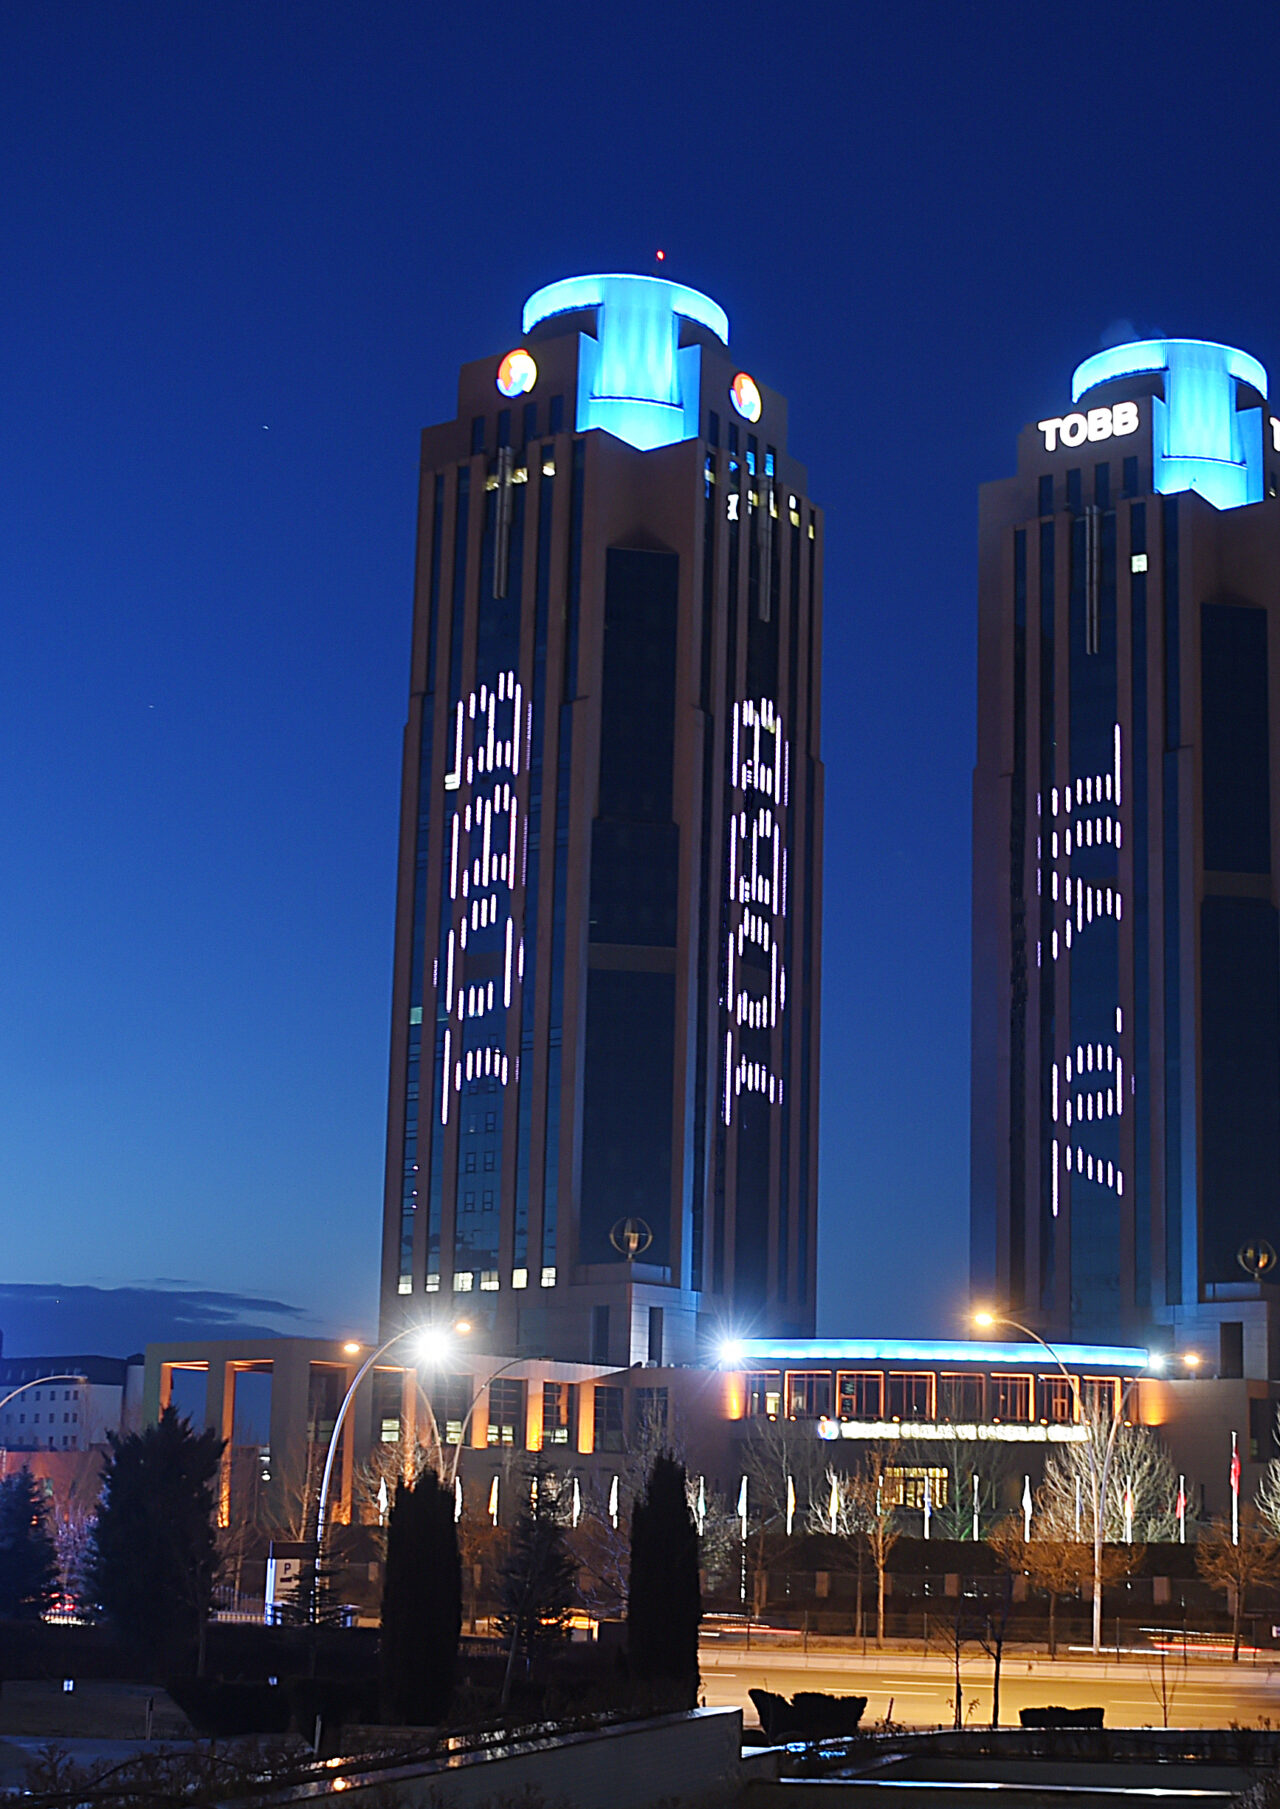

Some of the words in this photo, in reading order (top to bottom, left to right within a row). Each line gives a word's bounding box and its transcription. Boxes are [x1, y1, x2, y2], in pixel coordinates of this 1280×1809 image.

[1037, 401, 1140, 452] TOBB
[441, 670, 532, 1125] TOBB
[725, 697, 789, 1126] TOBB
[1037, 724, 1122, 967] YIL
[284, 1563, 291, 1575] P
